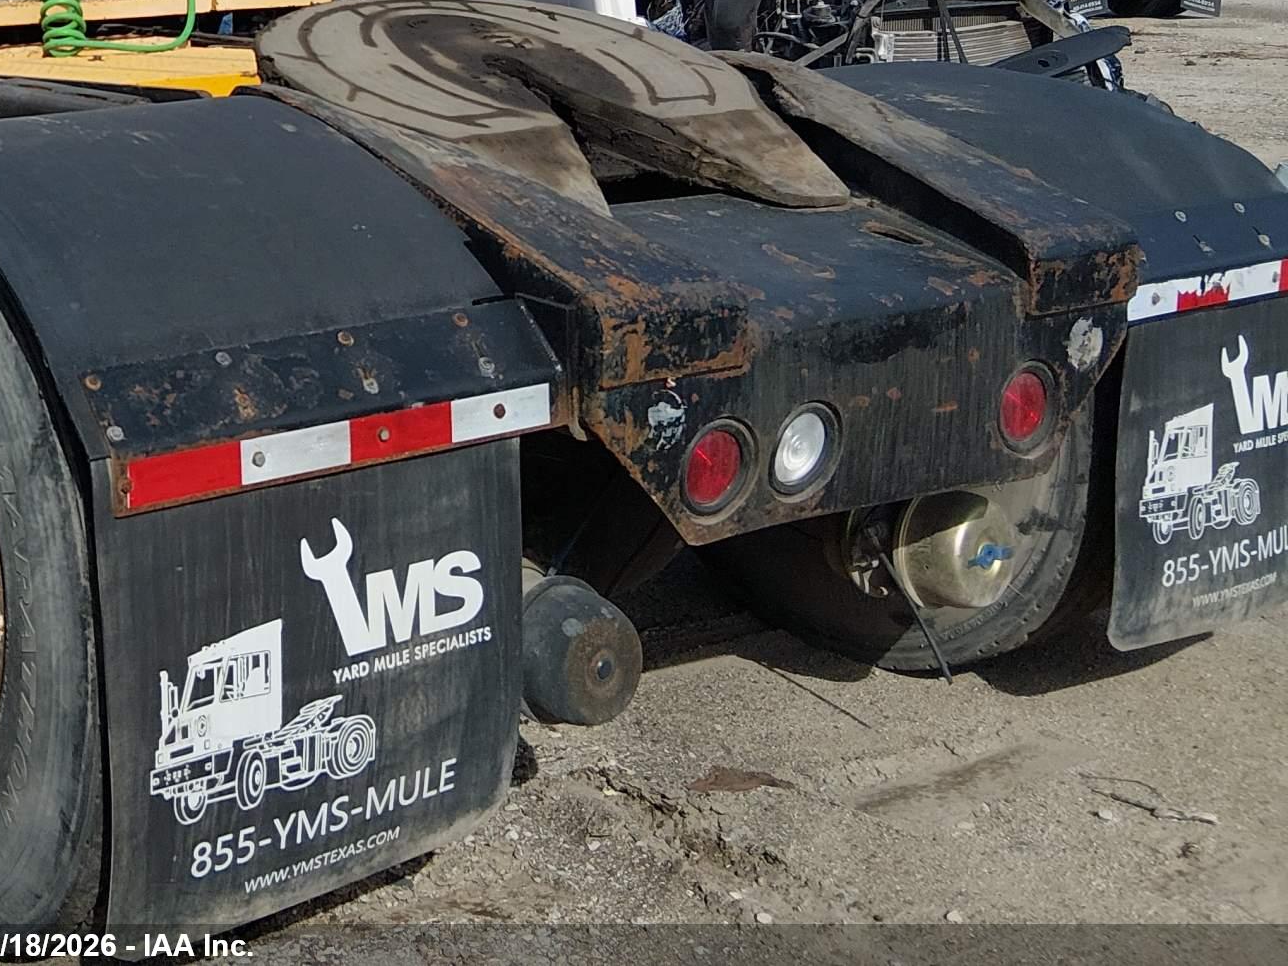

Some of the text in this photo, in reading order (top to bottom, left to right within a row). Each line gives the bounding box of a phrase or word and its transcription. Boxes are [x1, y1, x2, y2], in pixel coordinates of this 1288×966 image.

[1232, 439, 1254, 454] YARD
[1255, 434, 1277, 449] MULE
[1161, 524, 1288, 588] 855-YMS-MUL
[332, 626, 492, 685] YARD MULE SPECIALISTS
[190, 758, 457, 878] 855-YMS-MULE
[244, 826, 400, 894] WWW.YMSTEXAS.COM
